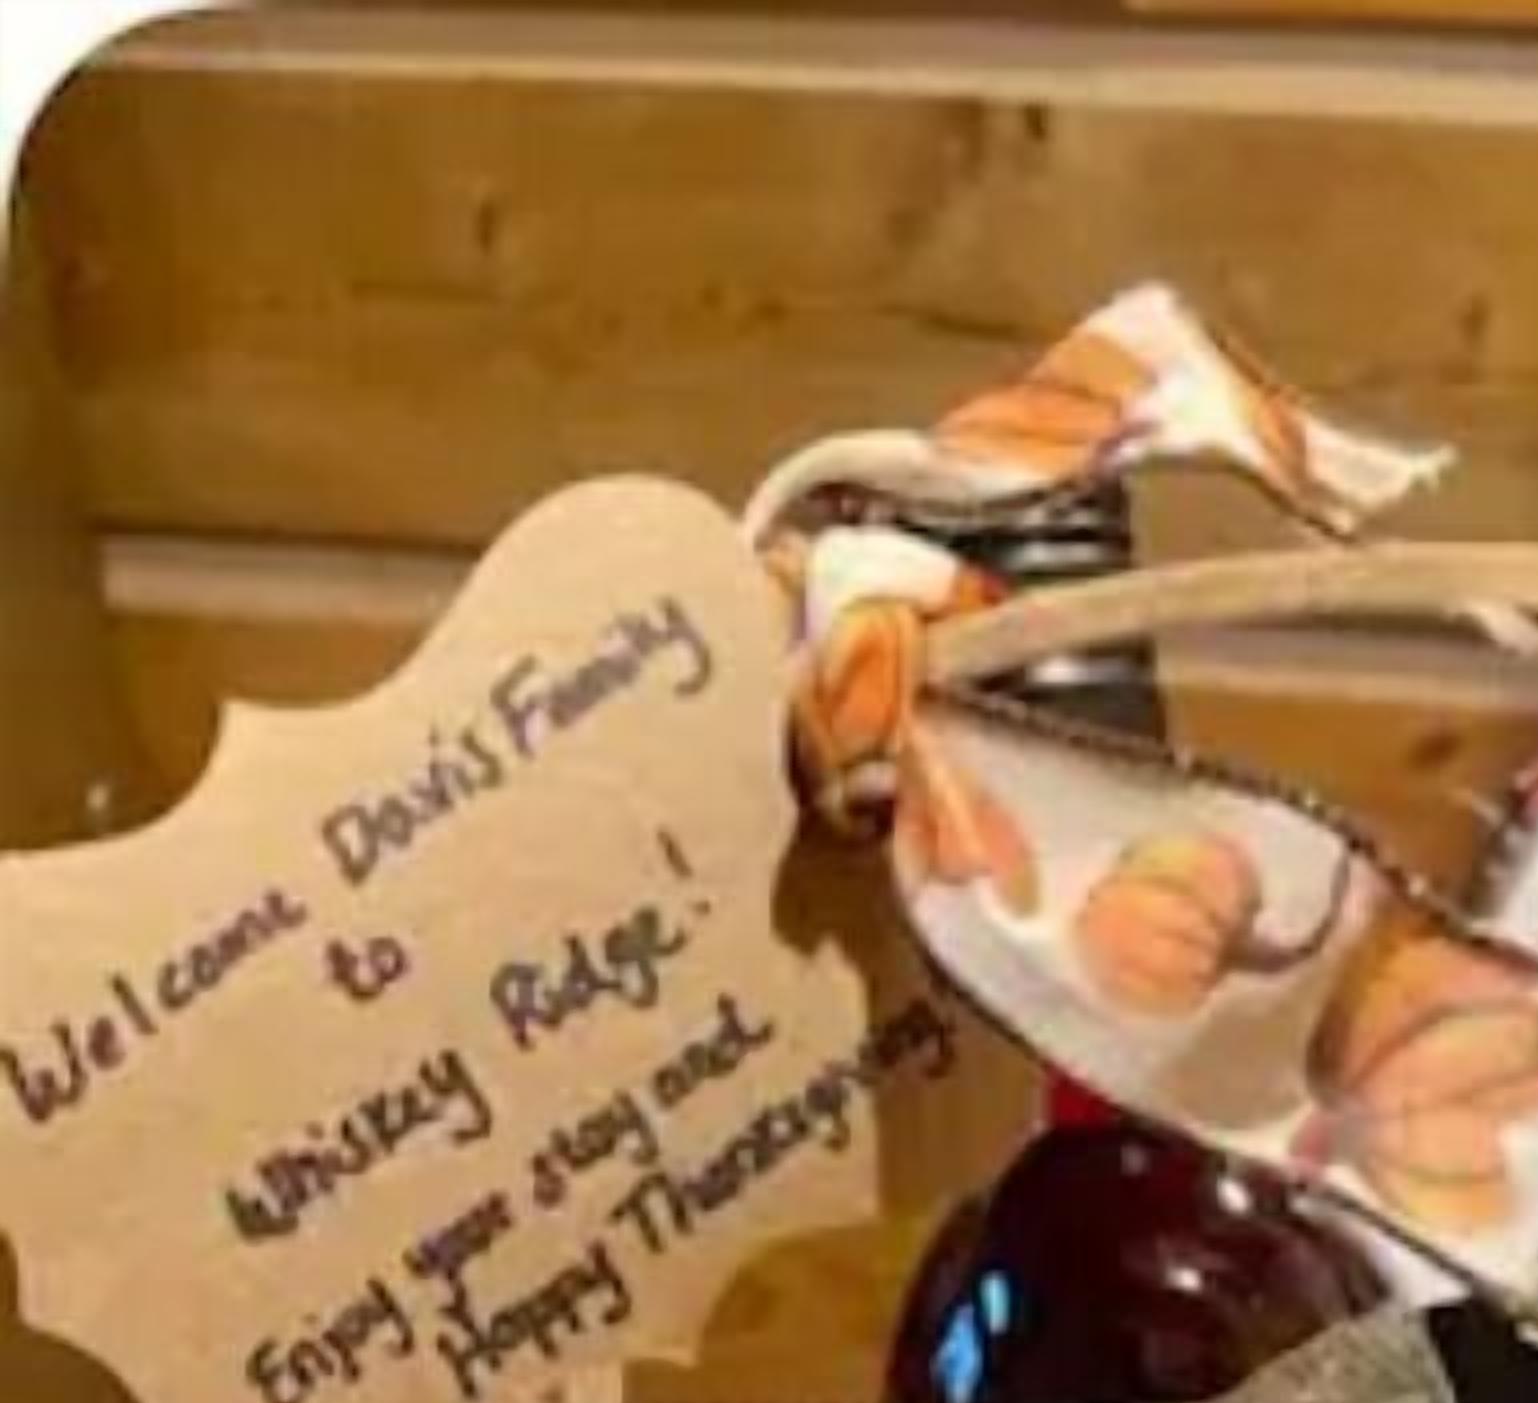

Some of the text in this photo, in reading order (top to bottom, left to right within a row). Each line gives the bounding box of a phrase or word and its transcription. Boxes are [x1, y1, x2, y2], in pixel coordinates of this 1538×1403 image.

[0, 597, 711, 1124] Welcome Davis Family
[226, 825, 711, 1242] Whiskey Ridge!
[326, 936, 406, 1003] to
[531, 1092, 658, 1206] stay
[651, 995, 772, 1112] and
[436, 1241, 632, 1399] Happy
